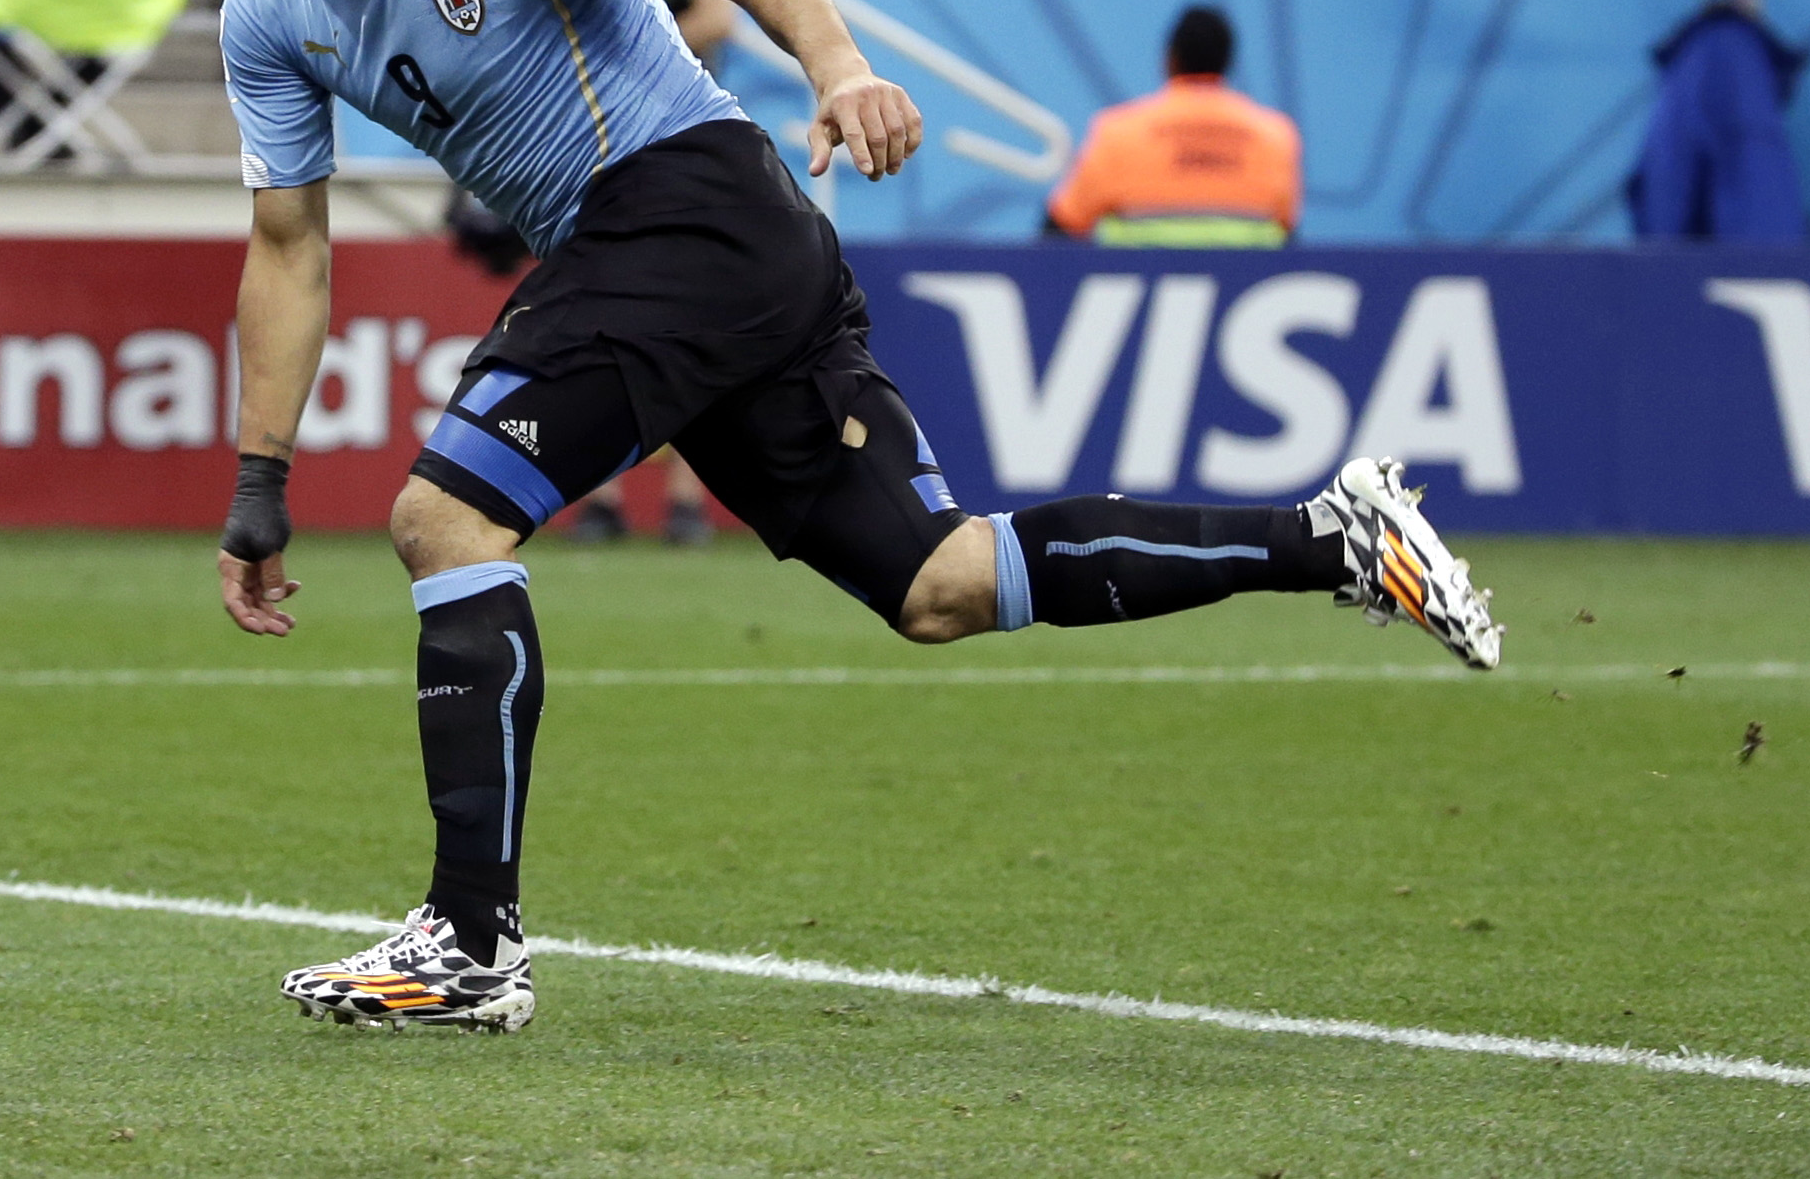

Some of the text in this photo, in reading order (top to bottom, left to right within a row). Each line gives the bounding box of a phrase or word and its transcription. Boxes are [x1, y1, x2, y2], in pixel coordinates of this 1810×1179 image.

[386, 53, 455, 129] 9
[904, 272, 1523, 497] VISA
[498, 420, 541, 456] adidas
[417, 685, 473, 700] GUAY
